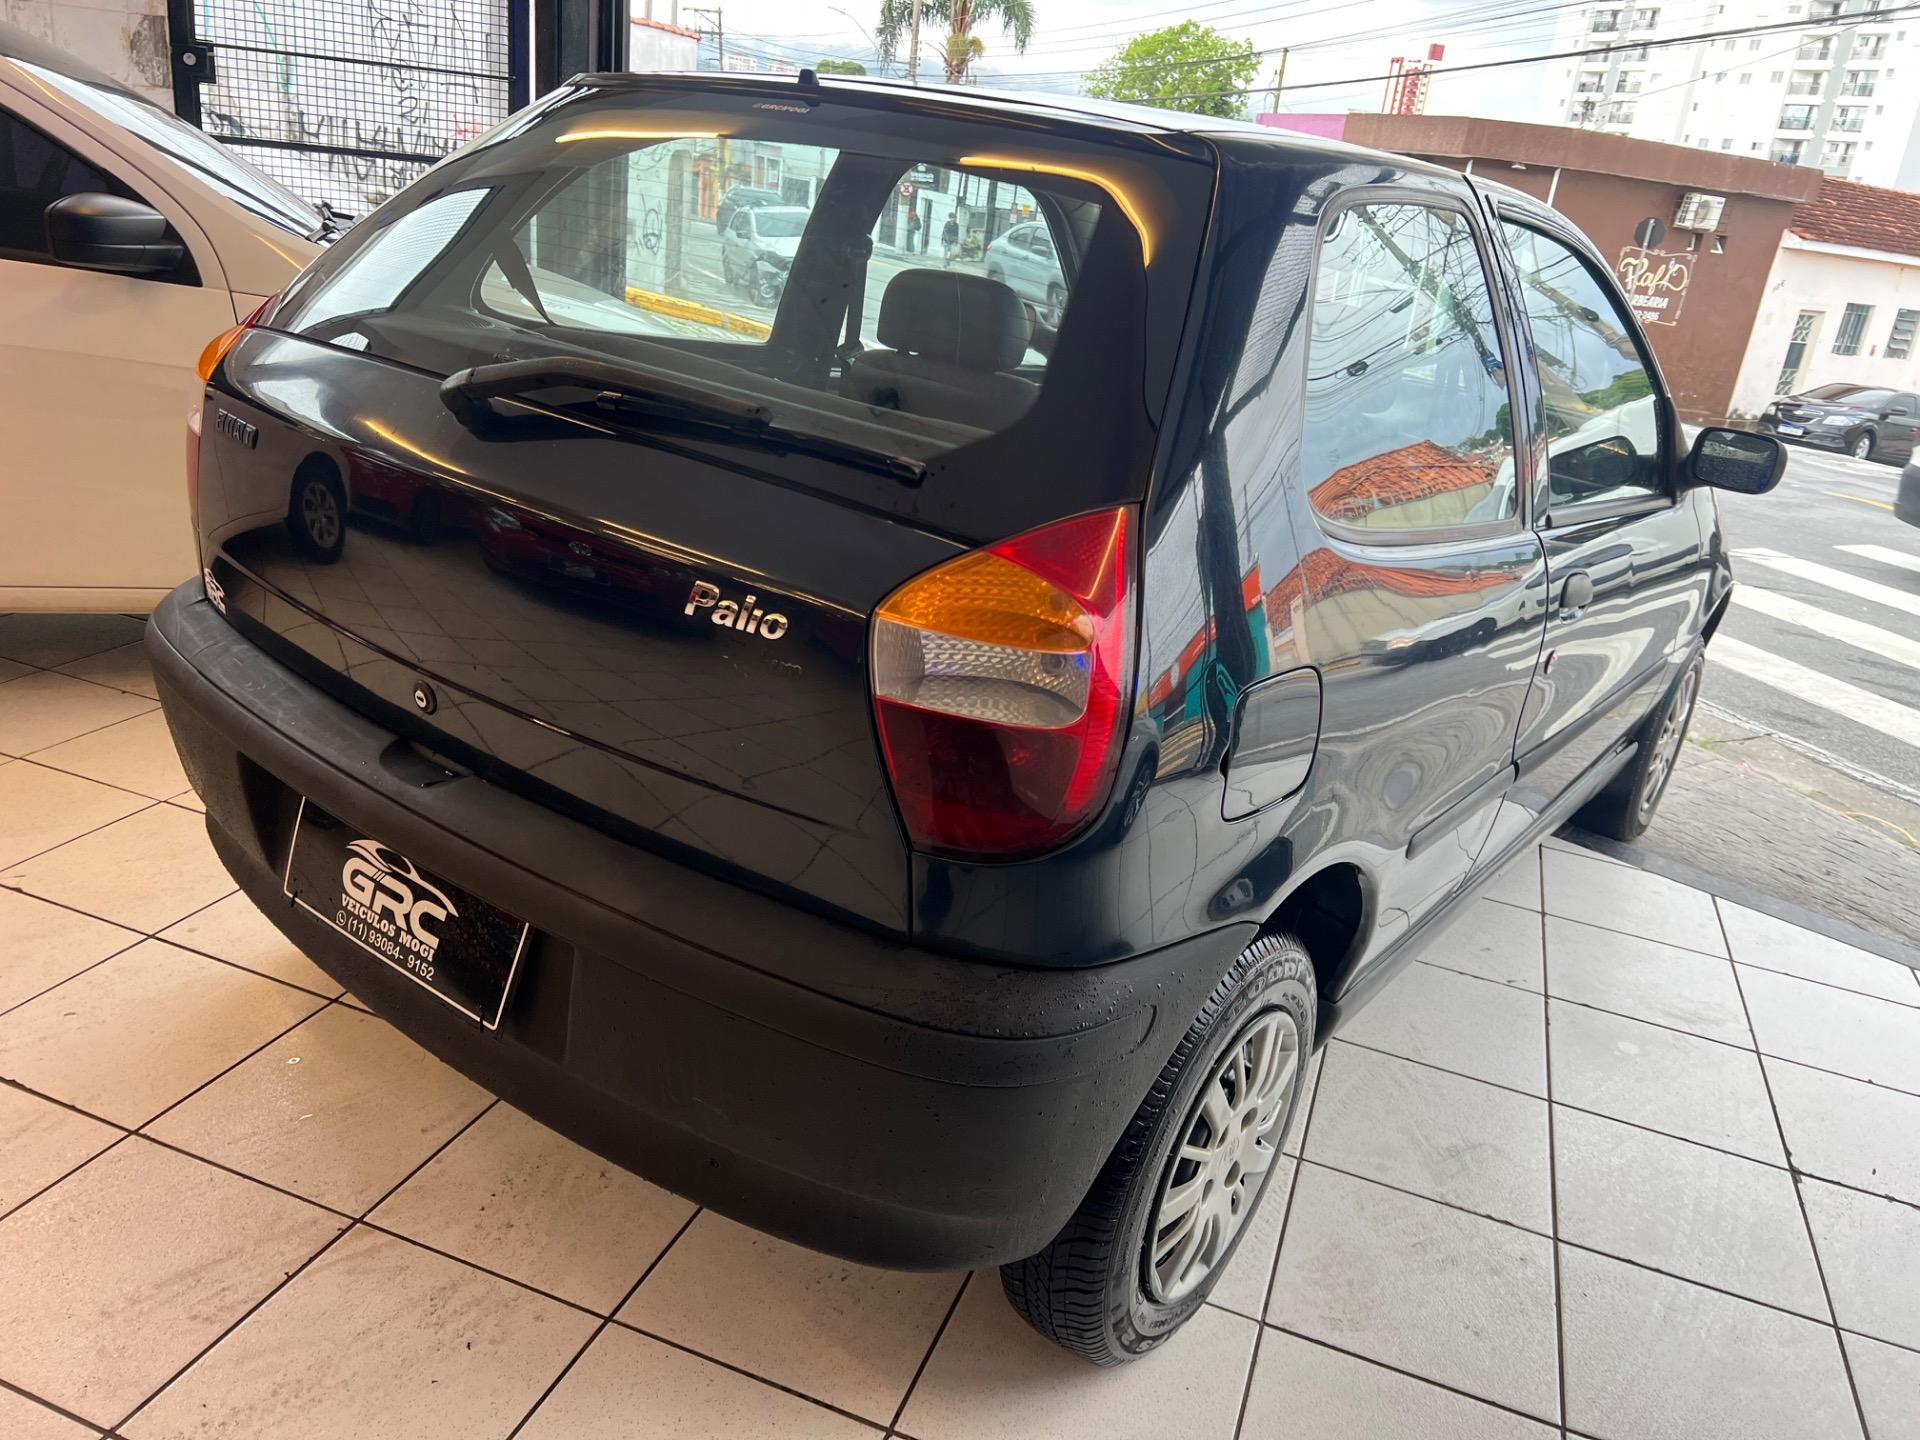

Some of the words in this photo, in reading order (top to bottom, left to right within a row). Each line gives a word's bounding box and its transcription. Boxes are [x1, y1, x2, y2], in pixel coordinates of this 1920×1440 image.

[684, 580, 788, 640] Palio
[341, 893, 396, 937] VEICULOS
[398, 930, 435, 962] MOGI
[342, 857, 447, 950] GRC
[407, 954, 435, 981] 9152
